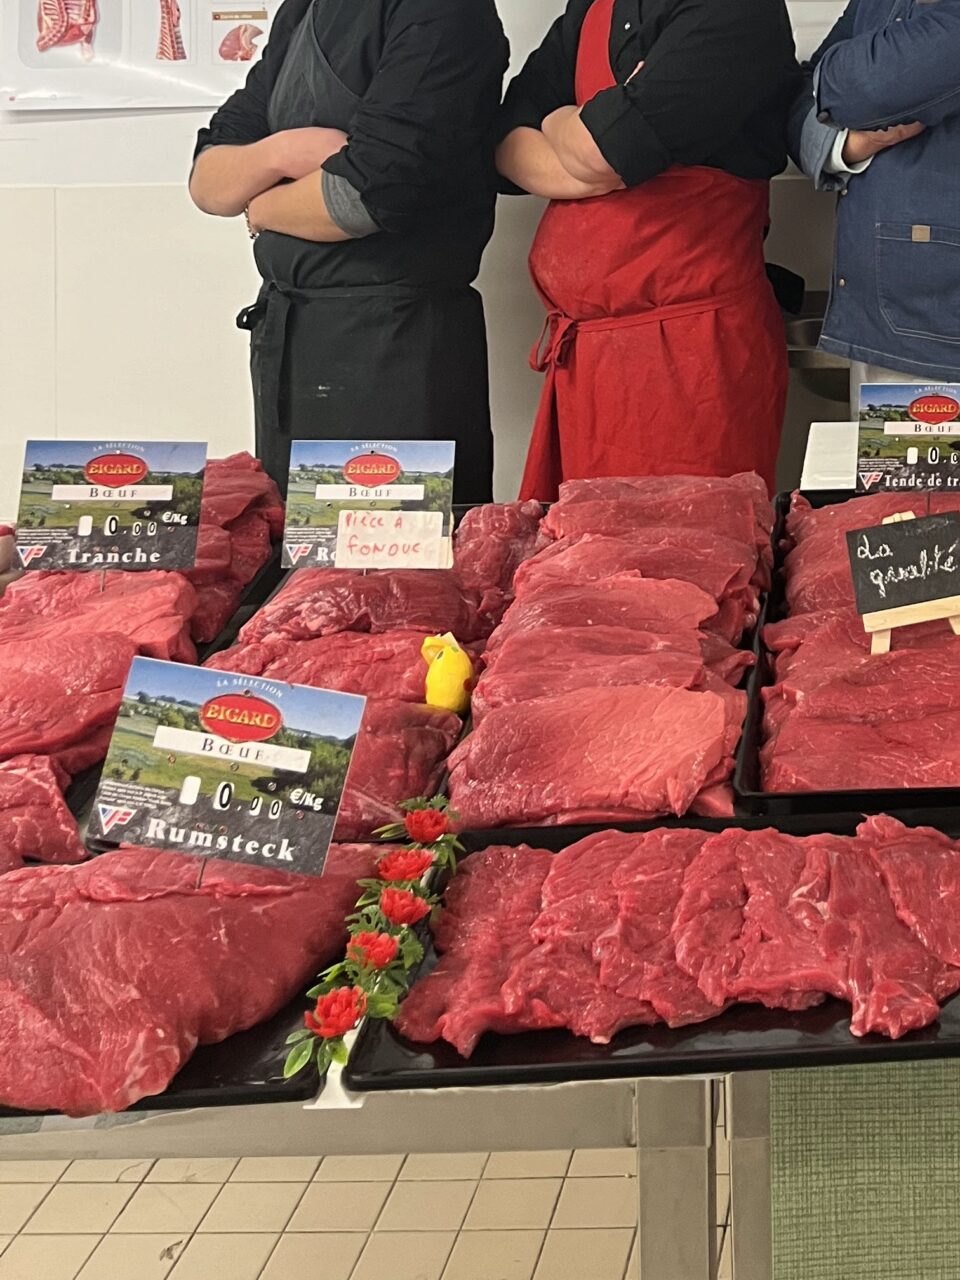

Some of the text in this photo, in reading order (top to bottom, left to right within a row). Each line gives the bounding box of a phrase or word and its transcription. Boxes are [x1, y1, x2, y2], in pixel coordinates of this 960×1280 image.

[912, 404, 958, 413] BIGARD
[88, 463, 143, 474] BIGARD
[347, 463, 397, 474] BIGARD
[884, 473, 923, 487] Tende
[927, 473, 942, 487] de
[67, 547, 161, 563] Tranche
[233, 677, 283, 698] SÉLECTION
[206, 704, 276, 730] BIGARD
[289, 788, 325, 811] €/Kg
[145, 818, 296, 862] Rumsteck
